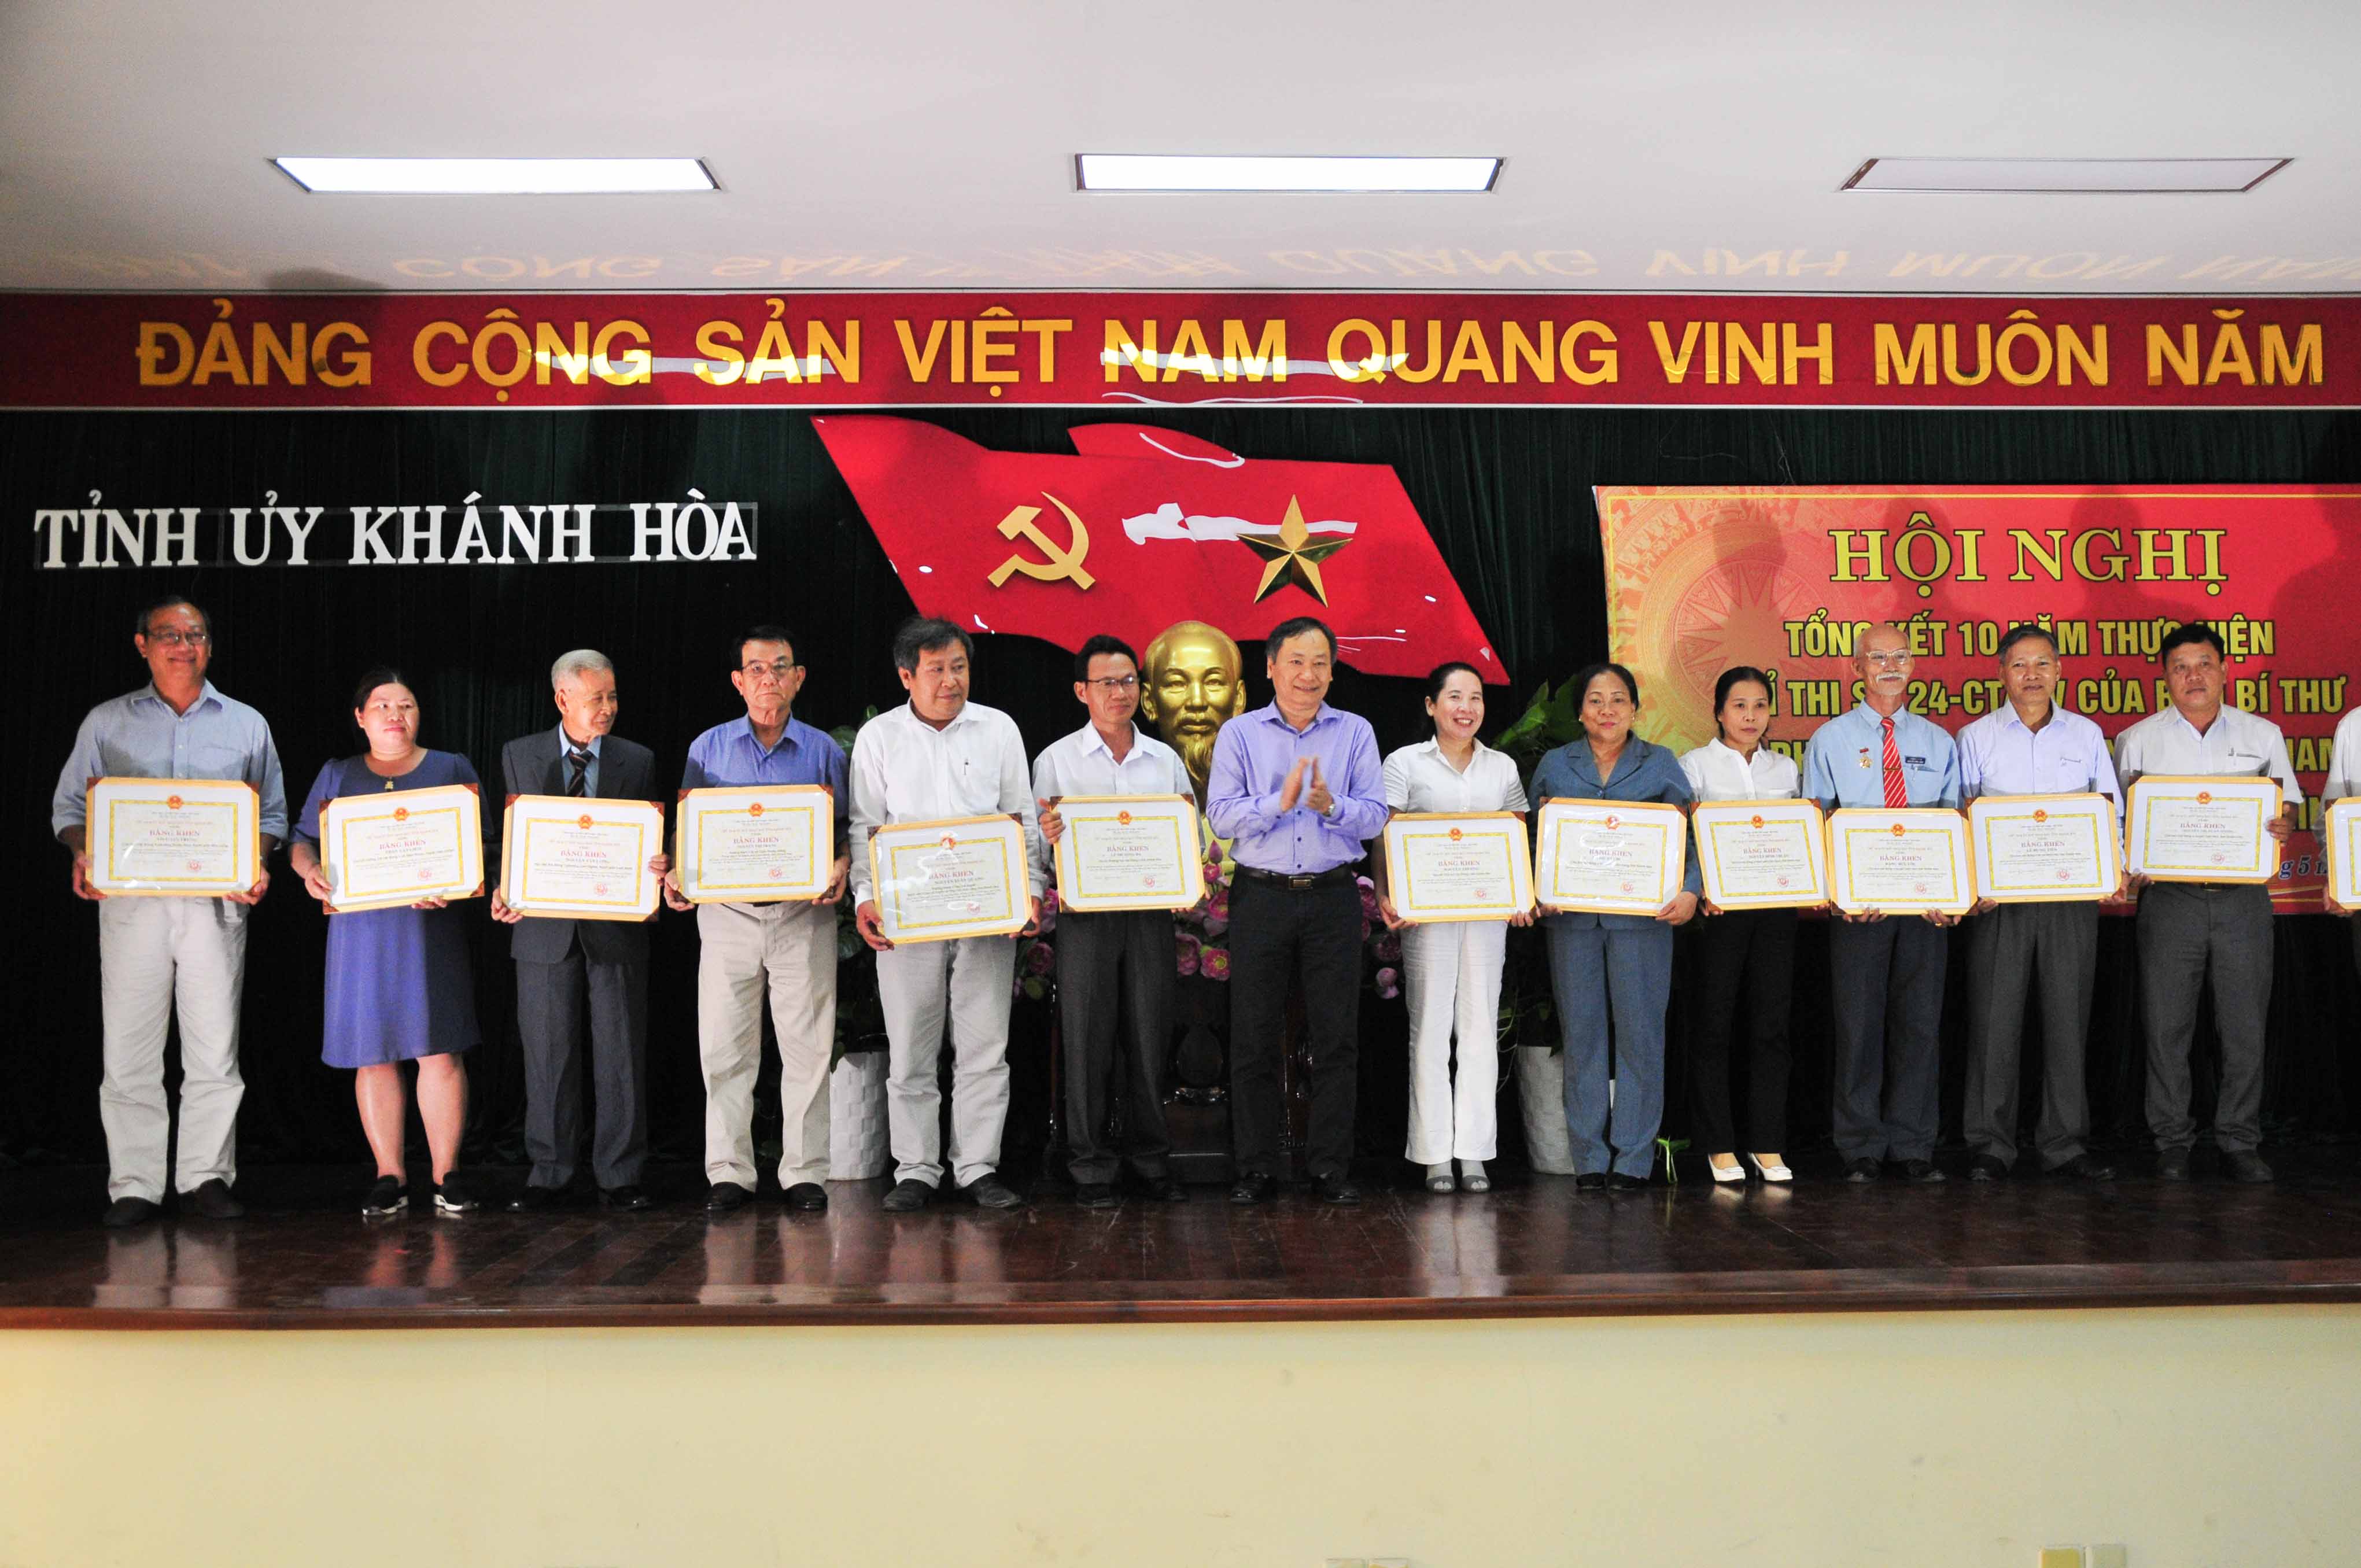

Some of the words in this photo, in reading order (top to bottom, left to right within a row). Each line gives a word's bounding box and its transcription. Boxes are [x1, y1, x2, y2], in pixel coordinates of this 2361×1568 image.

[135, 298, 372, 387] ĐẢNG
[412, 308, 652, 403] CỘNG
[693, 298, 861, 386] SẢN
[894, 307, 1073, 397] VIỆT
[1104, 319, 1287, 383] NAM
[1327, 319, 1618, 385] QUANG
[1647, 321, 1834, 386] VINH
[1874, 309, 2108, 387] MUÔN
[2146, 308, 2324, 386] NĂM
[34, 489, 201, 568] TỈNH
[230, 490, 324, 566] ỦY
[348, 490, 596, 565] KHÁNH
[629, 488, 757, 562] HÒA
[1828, 511, 1987, 599] HỘI
[2007, 527, 2229, 597] NGHỊ
[1783, 607, 1873, 658] TỔN
[1884, 608, 1949, 658] ẾT
[1957, 621, 1999, 656] 10
[2195, 612, 2277, 663] IỆN
[2075, 667, 2147, 715] CỦA
[2235, 670, 2271, 714] BÍ
[2278, 675, 2348, 713] THƯ
